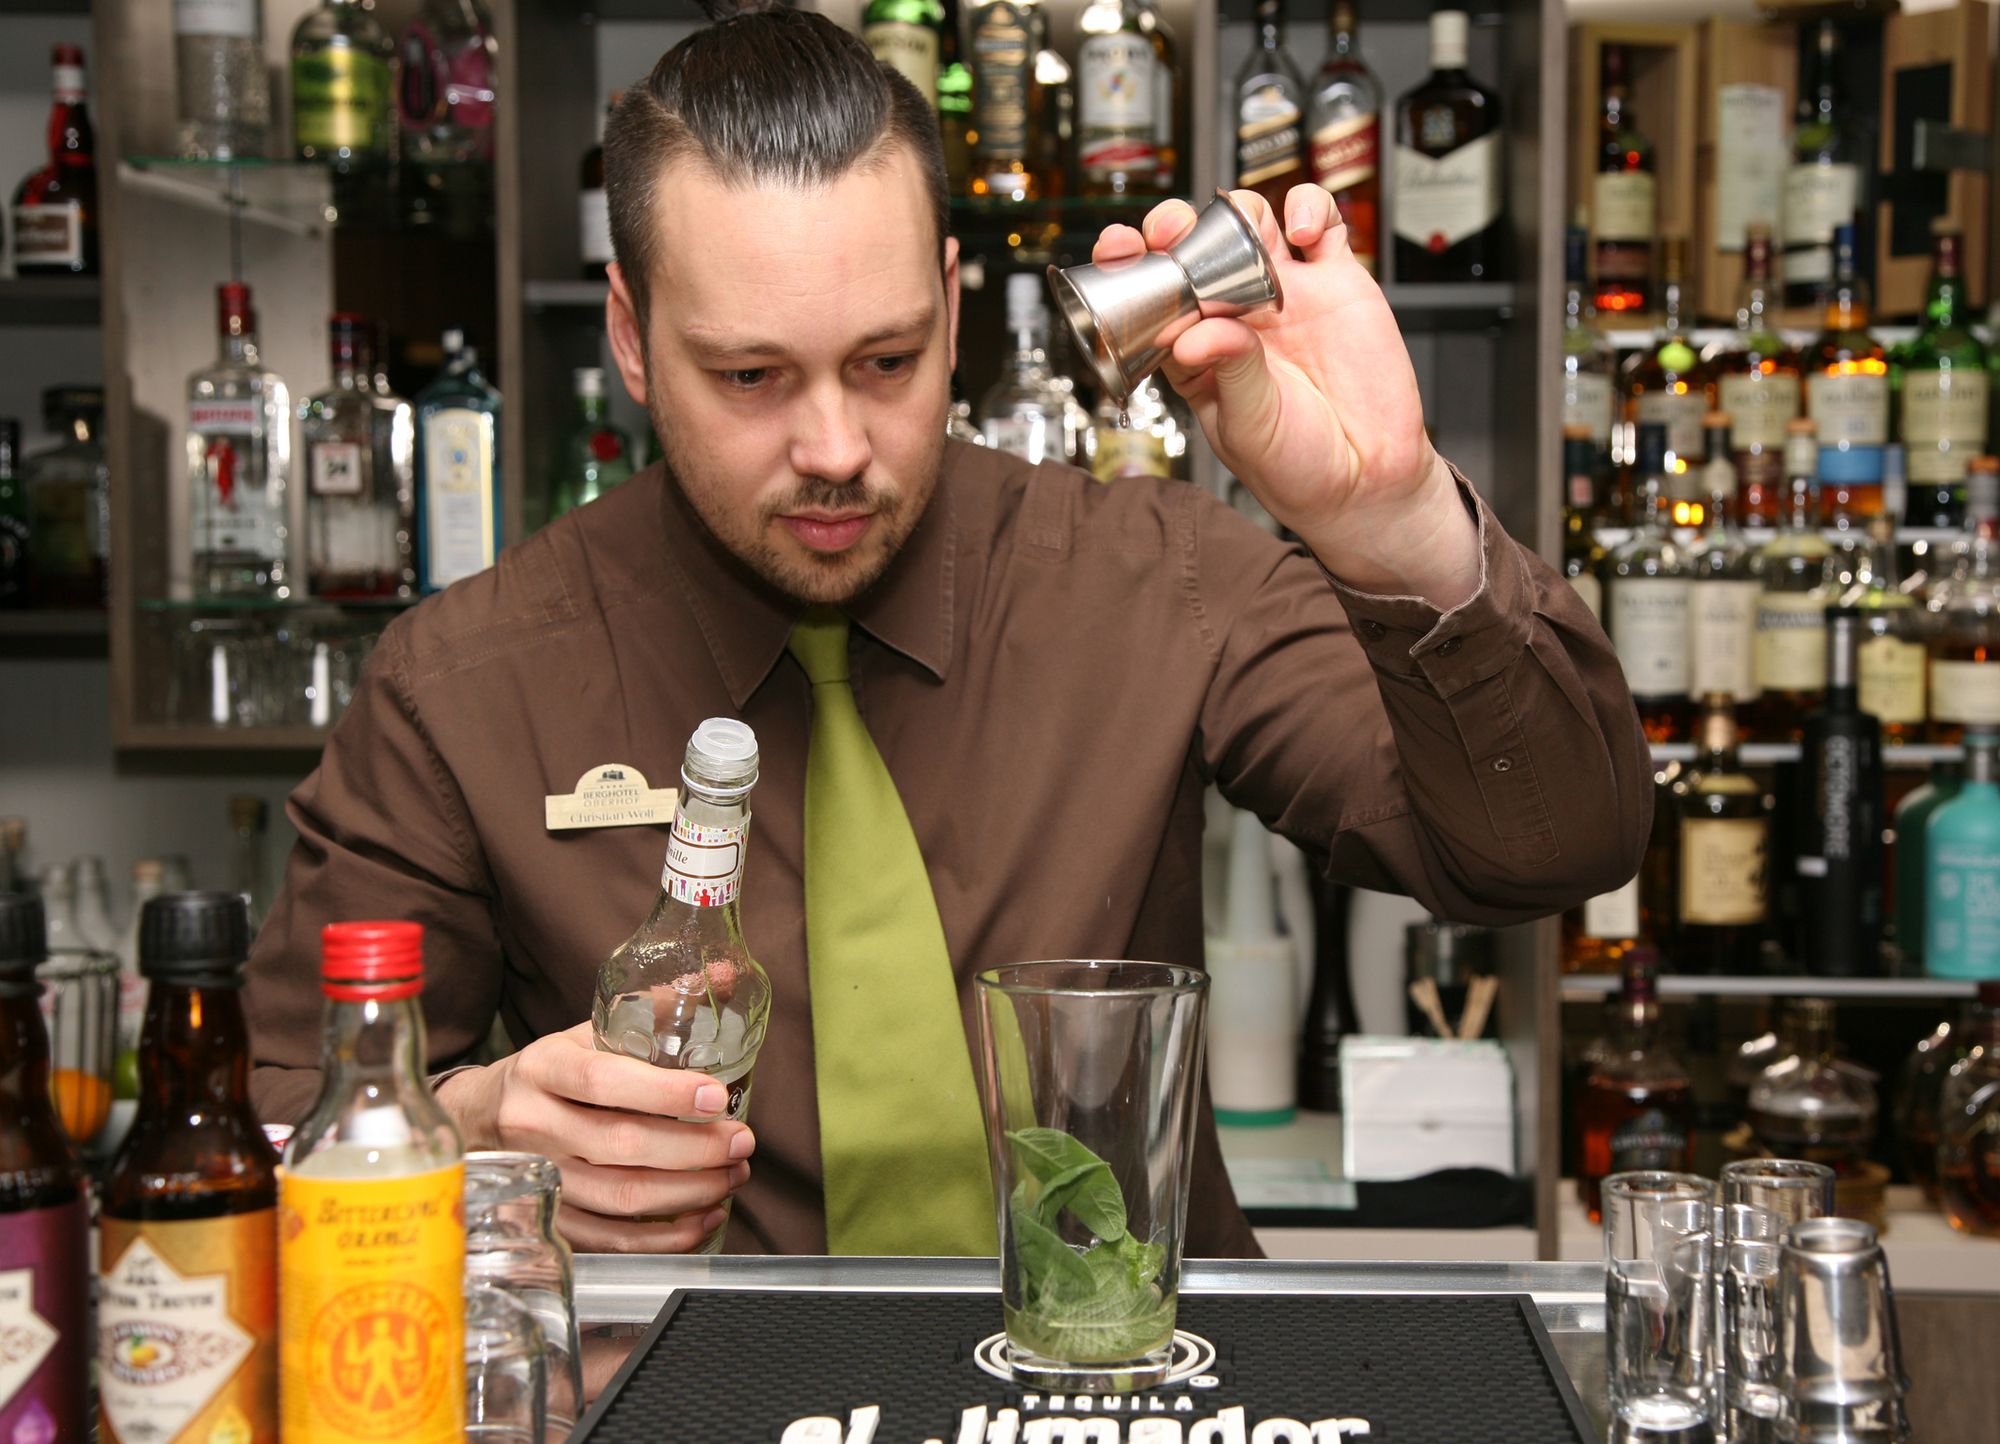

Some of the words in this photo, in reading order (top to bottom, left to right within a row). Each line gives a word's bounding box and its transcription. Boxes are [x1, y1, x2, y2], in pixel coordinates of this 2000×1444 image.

[583, 788, 640, 800] BERGHOTEL
[583, 797, 640, 808] OBERHOF
[570, 811, 625, 823] Christian
[1022, 1394, 1194, 1412] TEQUILA
